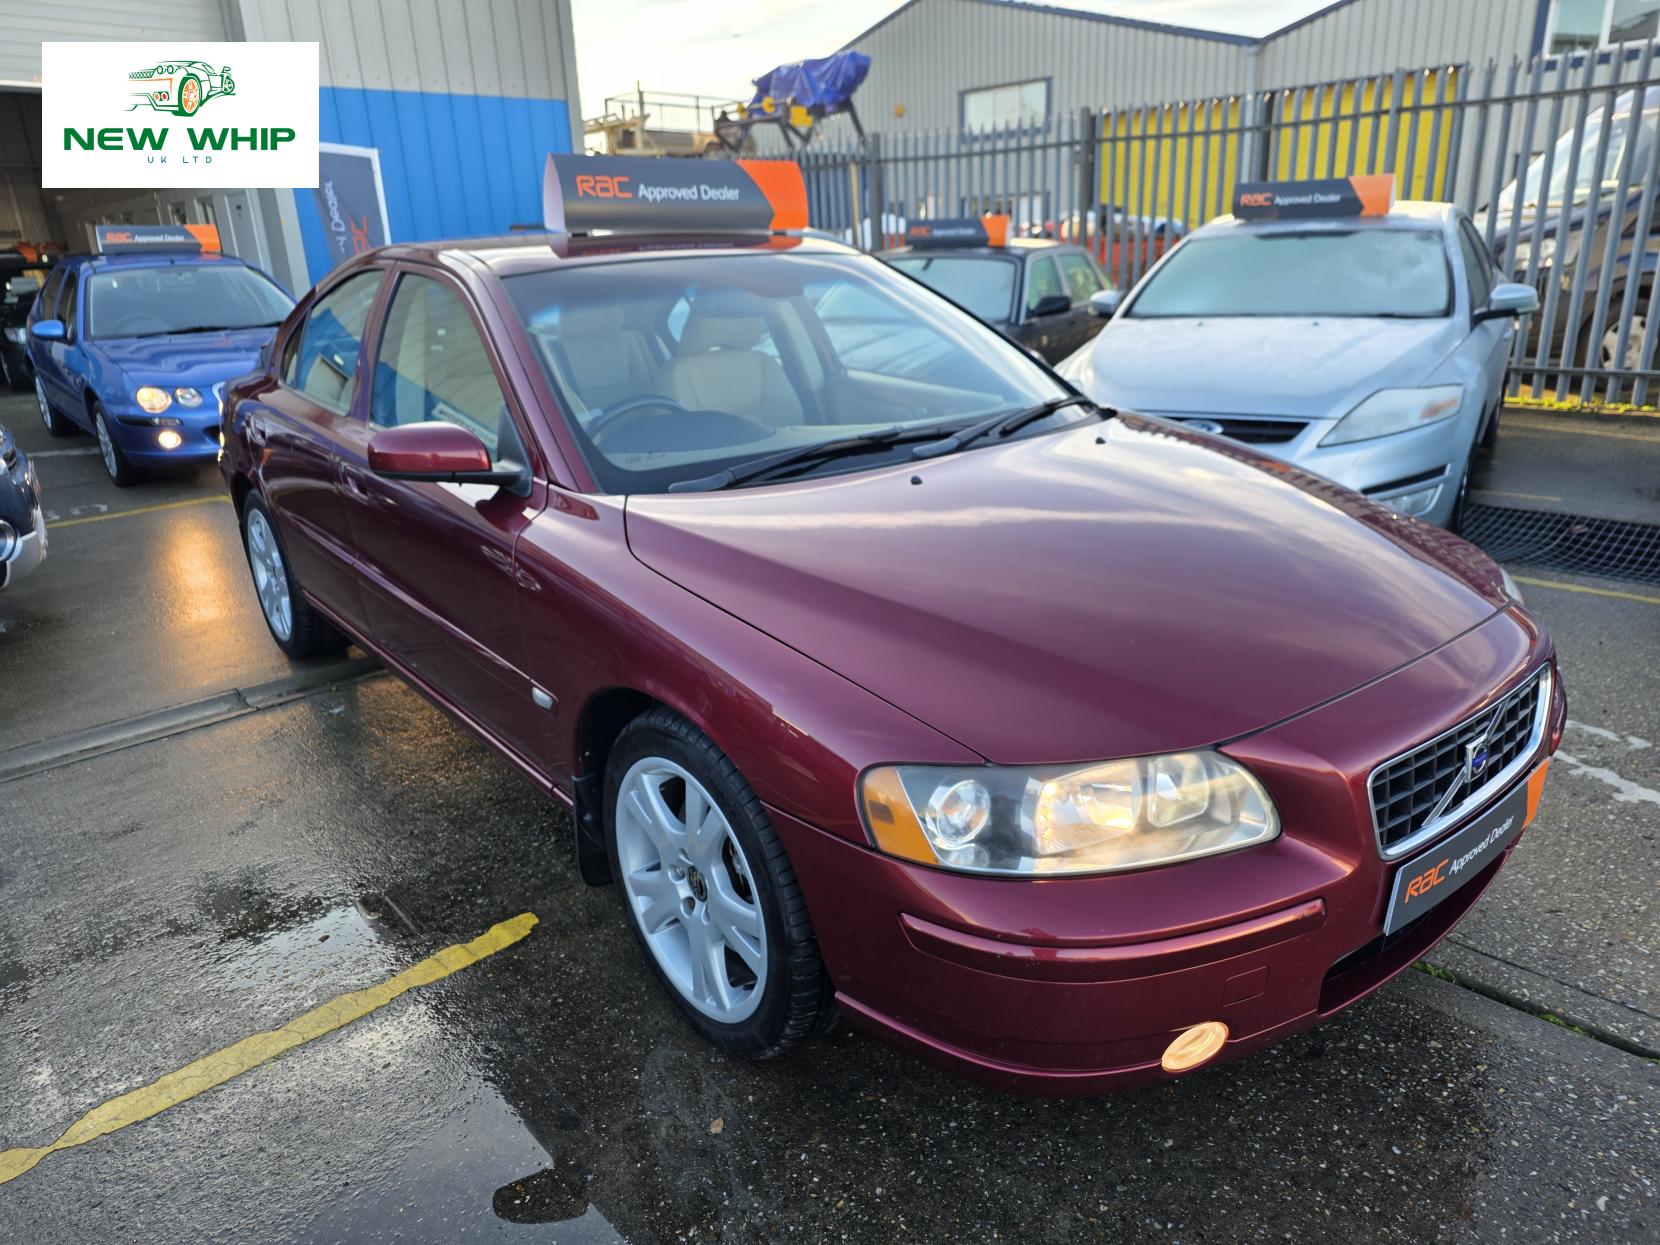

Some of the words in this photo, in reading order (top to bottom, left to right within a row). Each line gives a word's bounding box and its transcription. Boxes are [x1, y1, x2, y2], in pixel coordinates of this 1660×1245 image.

[638, 183, 699, 202] Approved
[700, 184, 740, 201] Dealer
[1448, 834, 1491, 877] Approved
[1489, 815, 1515, 844] Dealer
